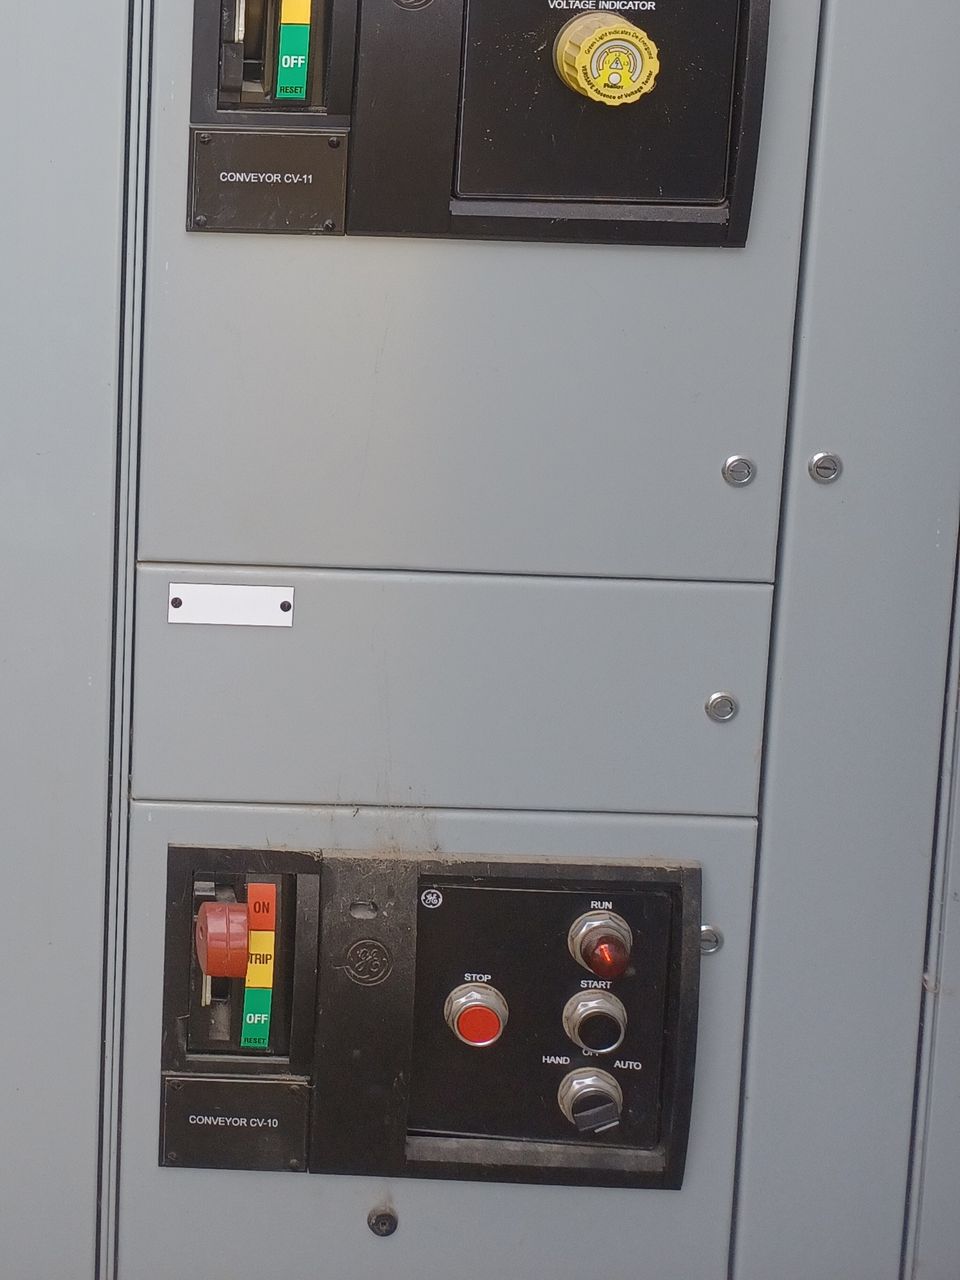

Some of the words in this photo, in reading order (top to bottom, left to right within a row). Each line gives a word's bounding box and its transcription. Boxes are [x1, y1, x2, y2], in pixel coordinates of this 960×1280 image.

[548, 0, 596, 9] VOLTAGE
[598, 0, 656, 10] INDICATOR
[281, 55, 306, 68] OFF
[279, 86, 304, 94] RESET
[219, 172, 282, 183] CONVEYOR
[283, 173, 313, 184] CV-11
[253, 901, 270, 914] ON
[590, 900, 613, 909] RUN
[249, 953, 272, 965] TRIP
[464, 972, 491, 982] STOP
[579, 980, 612, 989] START
[246, 1013, 268, 1024] OFF
[542, 1055, 570, 1065] HAND
[613, 1059, 642, 1070] AUTO
[188, 1115, 248, 1127] CONVEYOR
[249, 1118, 279, 1128] CV-10
